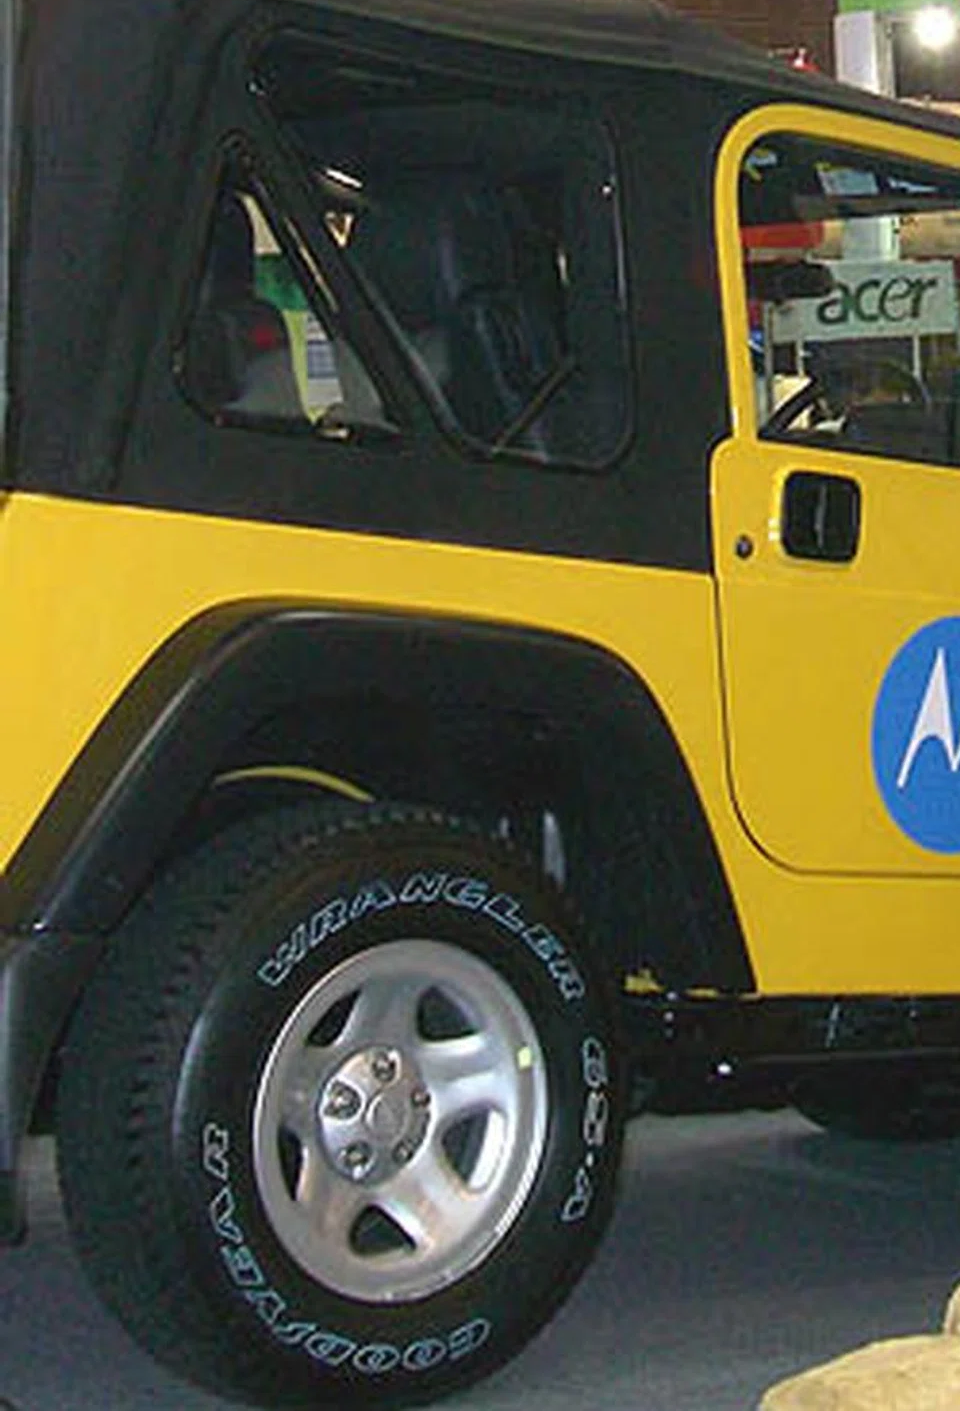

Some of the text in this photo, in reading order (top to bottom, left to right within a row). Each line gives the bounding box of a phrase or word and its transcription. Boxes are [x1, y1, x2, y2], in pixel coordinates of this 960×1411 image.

[816, 276, 938, 326] acer
[257, 873, 586, 1003] WRANGLER
[203, 1123, 493, 1373] GOODYEAR
